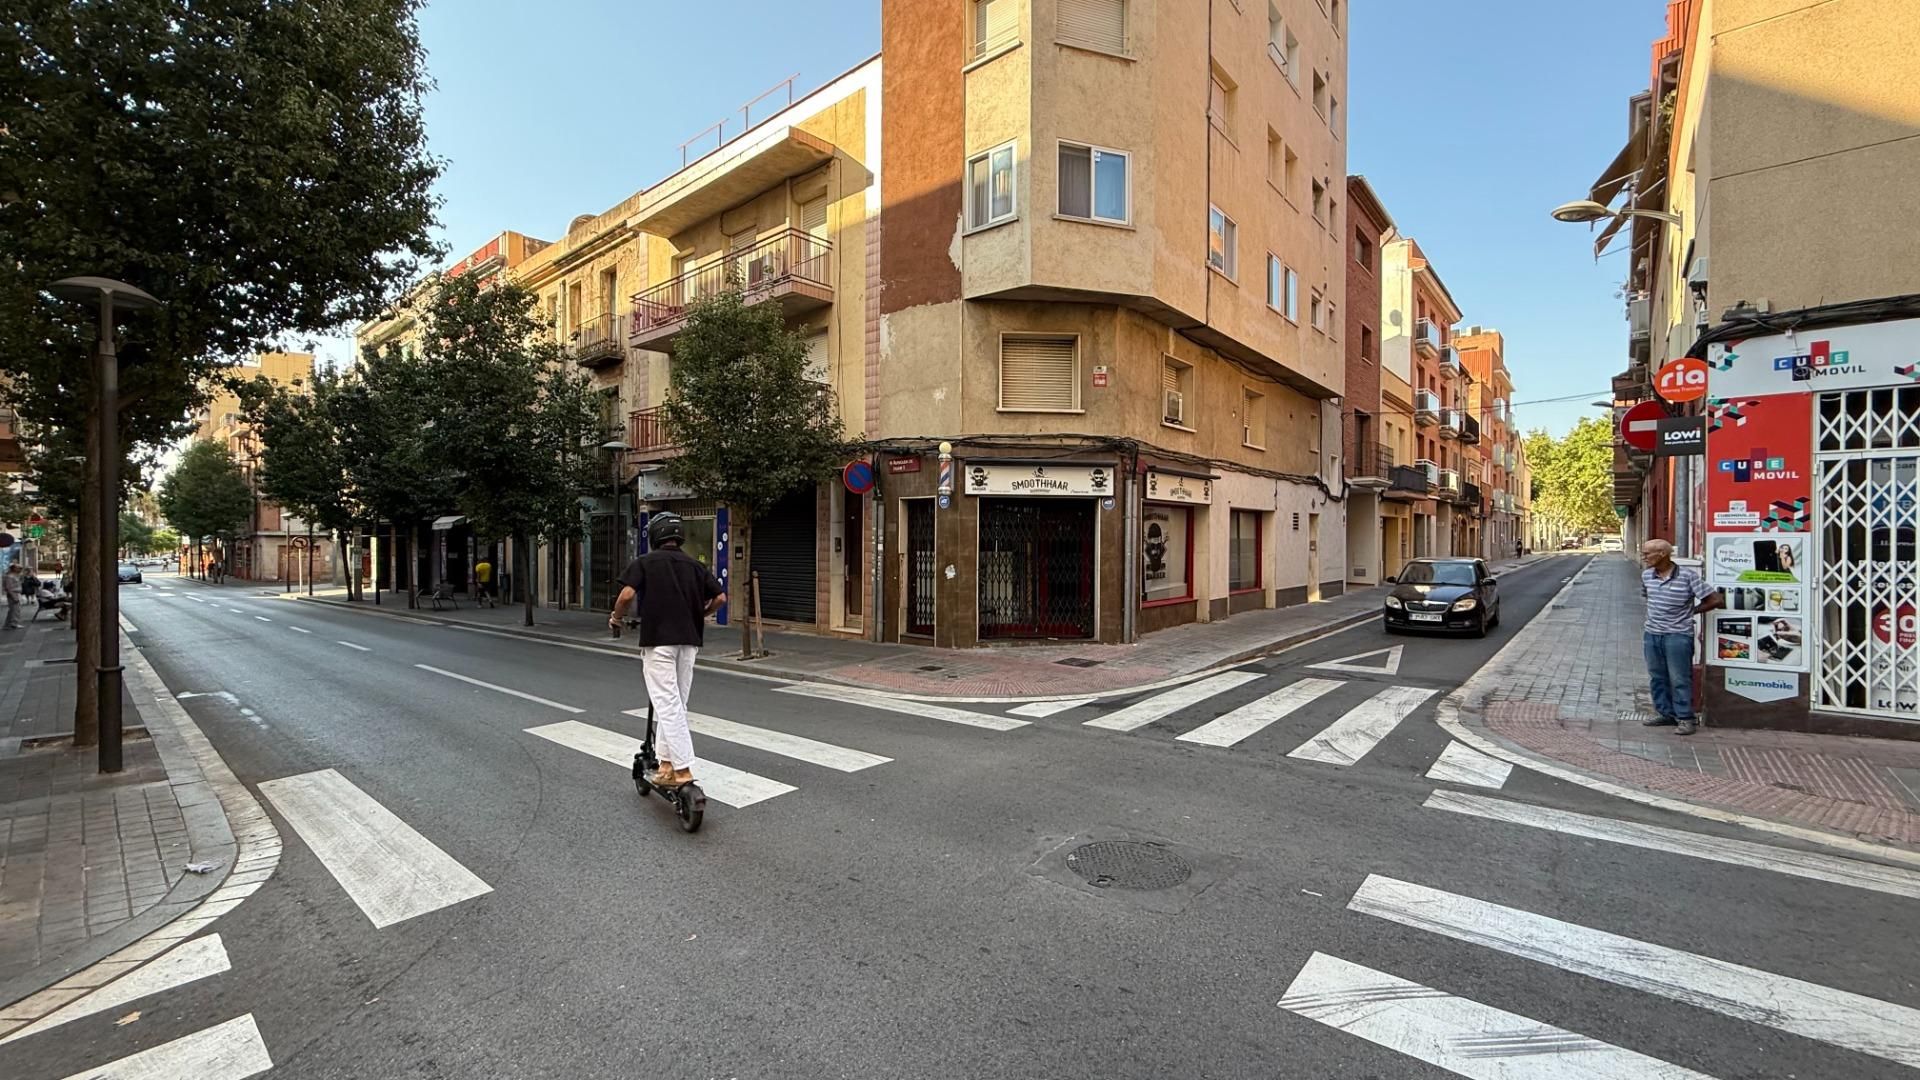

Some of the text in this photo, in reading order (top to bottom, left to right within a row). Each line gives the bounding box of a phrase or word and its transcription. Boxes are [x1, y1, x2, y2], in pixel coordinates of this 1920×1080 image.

[1778, 352, 1844, 369] CUBE
[1661, 364, 1706, 388] ria
[1815, 365, 1866, 377] MOVIL
[1721, 459, 1779, 471] CUBE
[1753, 471, 1800, 480] MOVIL
[1011, 478, 1069, 491] SMOOTHHAAR
[1727, 677, 1794, 691] Lycamobile
